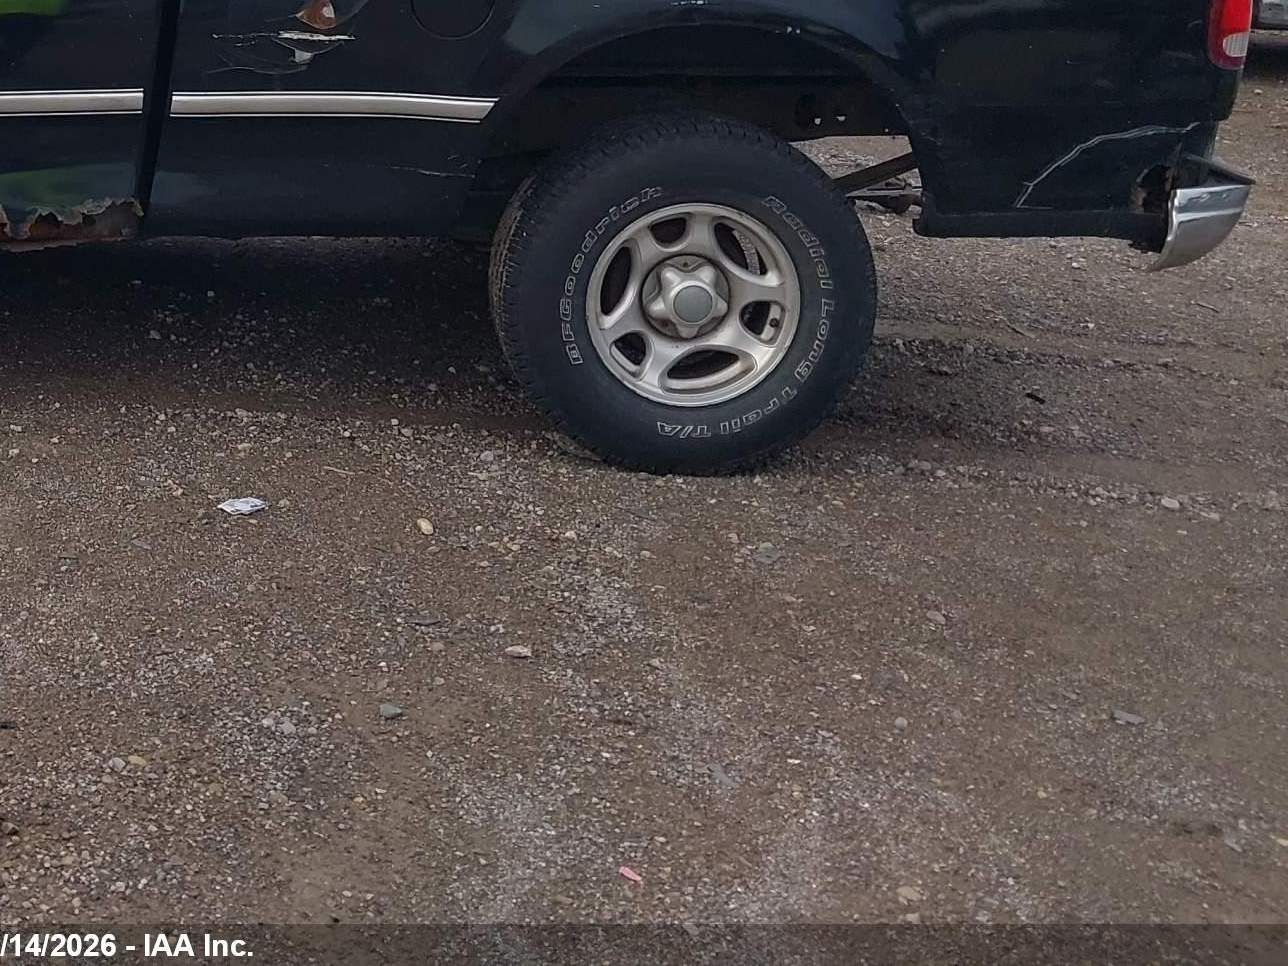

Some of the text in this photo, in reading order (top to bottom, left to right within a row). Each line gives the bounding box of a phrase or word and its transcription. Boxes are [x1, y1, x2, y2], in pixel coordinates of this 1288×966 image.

[560, 186, 663, 365] BFGoodrich
[656, 195, 835, 438] Radial Long Trail T/A
